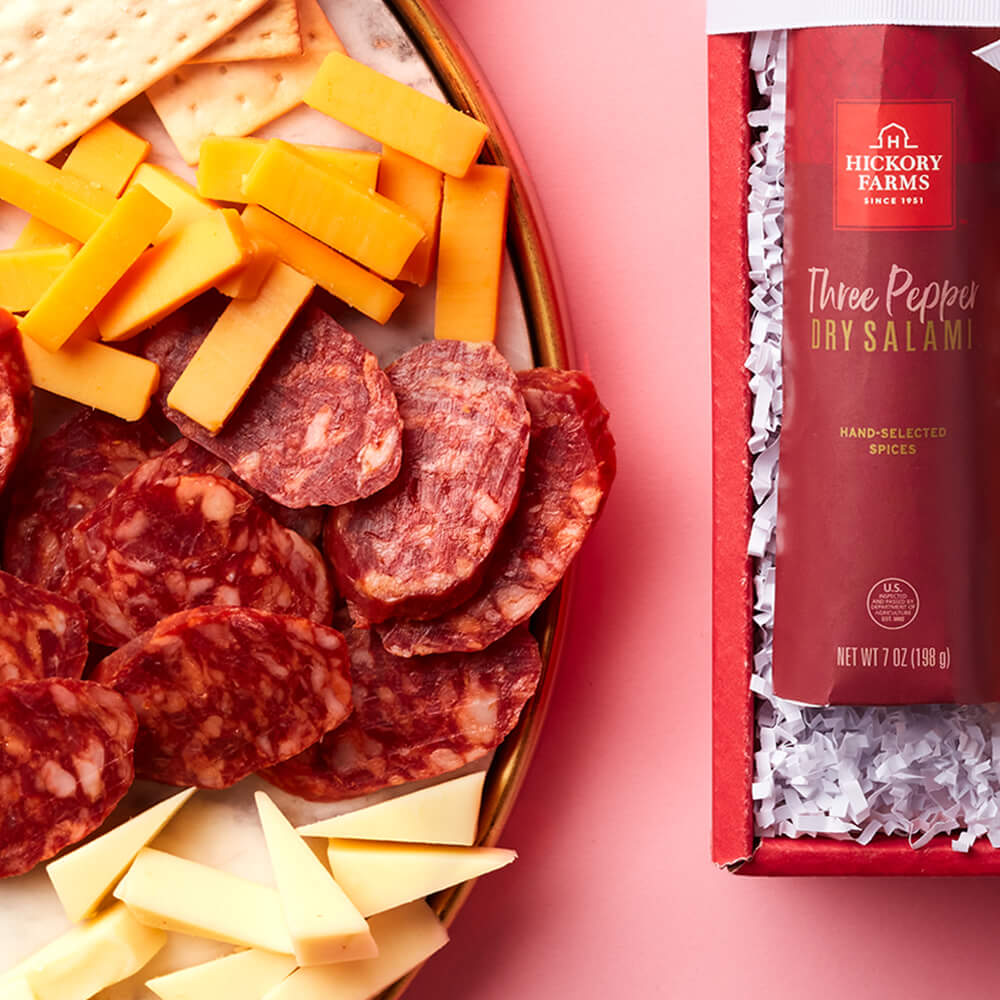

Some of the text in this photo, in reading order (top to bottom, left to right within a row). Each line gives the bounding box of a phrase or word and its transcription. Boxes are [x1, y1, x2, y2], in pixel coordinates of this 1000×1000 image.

[887, 136, 899, 149] H
[846, 154, 943, 172] HICKORY
[858, 175, 931, 191] FARMS
[864, 196, 924, 205] SINCE 1951
[808, 264, 980, 324] Three Pepper
[811, 318, 973, 352] DRY SALAMI
[840, 427, 947, 439] HAND-SELECTED
[869, 443, 917, 455] SPICES
[883, 583, 903, 593] U.S.
[837, 646, 858, 667] NET
[861, 647, 880, 667] WT
[882, 647, 889, 667] 7
[893, 647, 908, 667] OZ
[911, 647, 936, 669] (198
